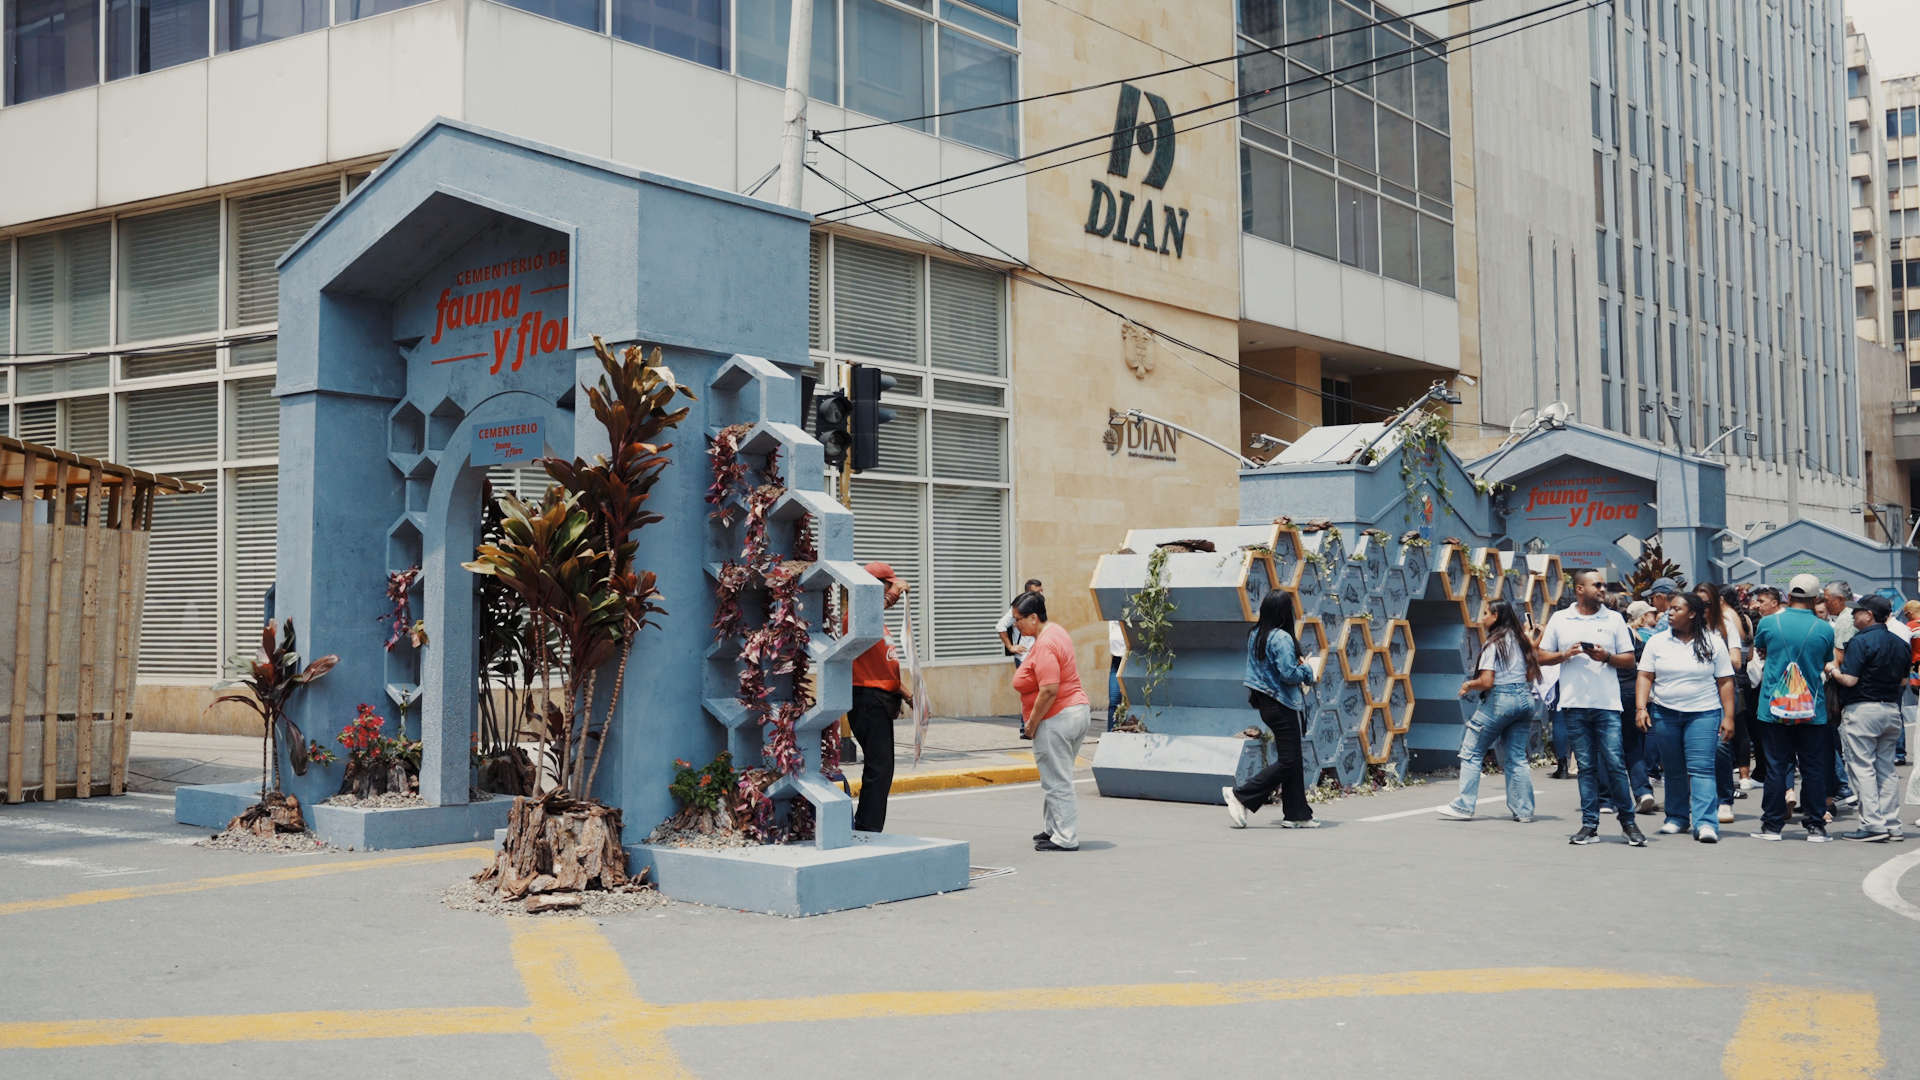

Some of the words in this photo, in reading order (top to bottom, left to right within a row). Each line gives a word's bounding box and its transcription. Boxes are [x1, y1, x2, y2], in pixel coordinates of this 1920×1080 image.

[1085, 180, 1189, 259] DIAN
[457, 254, 543, 286] CEMENTERIO
[549, 249, 566, 267] DE
[431, 284, 521, 345] fauna
[490, 326, 512, 375] y
[512, 310, 568, 372] flor
[478, 422, 538, 439] CEMENTERIO
[1127, 420, 1177, 454] DIAN
[1543, 476, 1603, 487] CEMENTERIO
[1607, 476, 1619, 484] DE
[1526, 487, 1589, 512] fauna
[1568, 506, 1584, 527] y
[1583, 501, 1639, 527] flora
